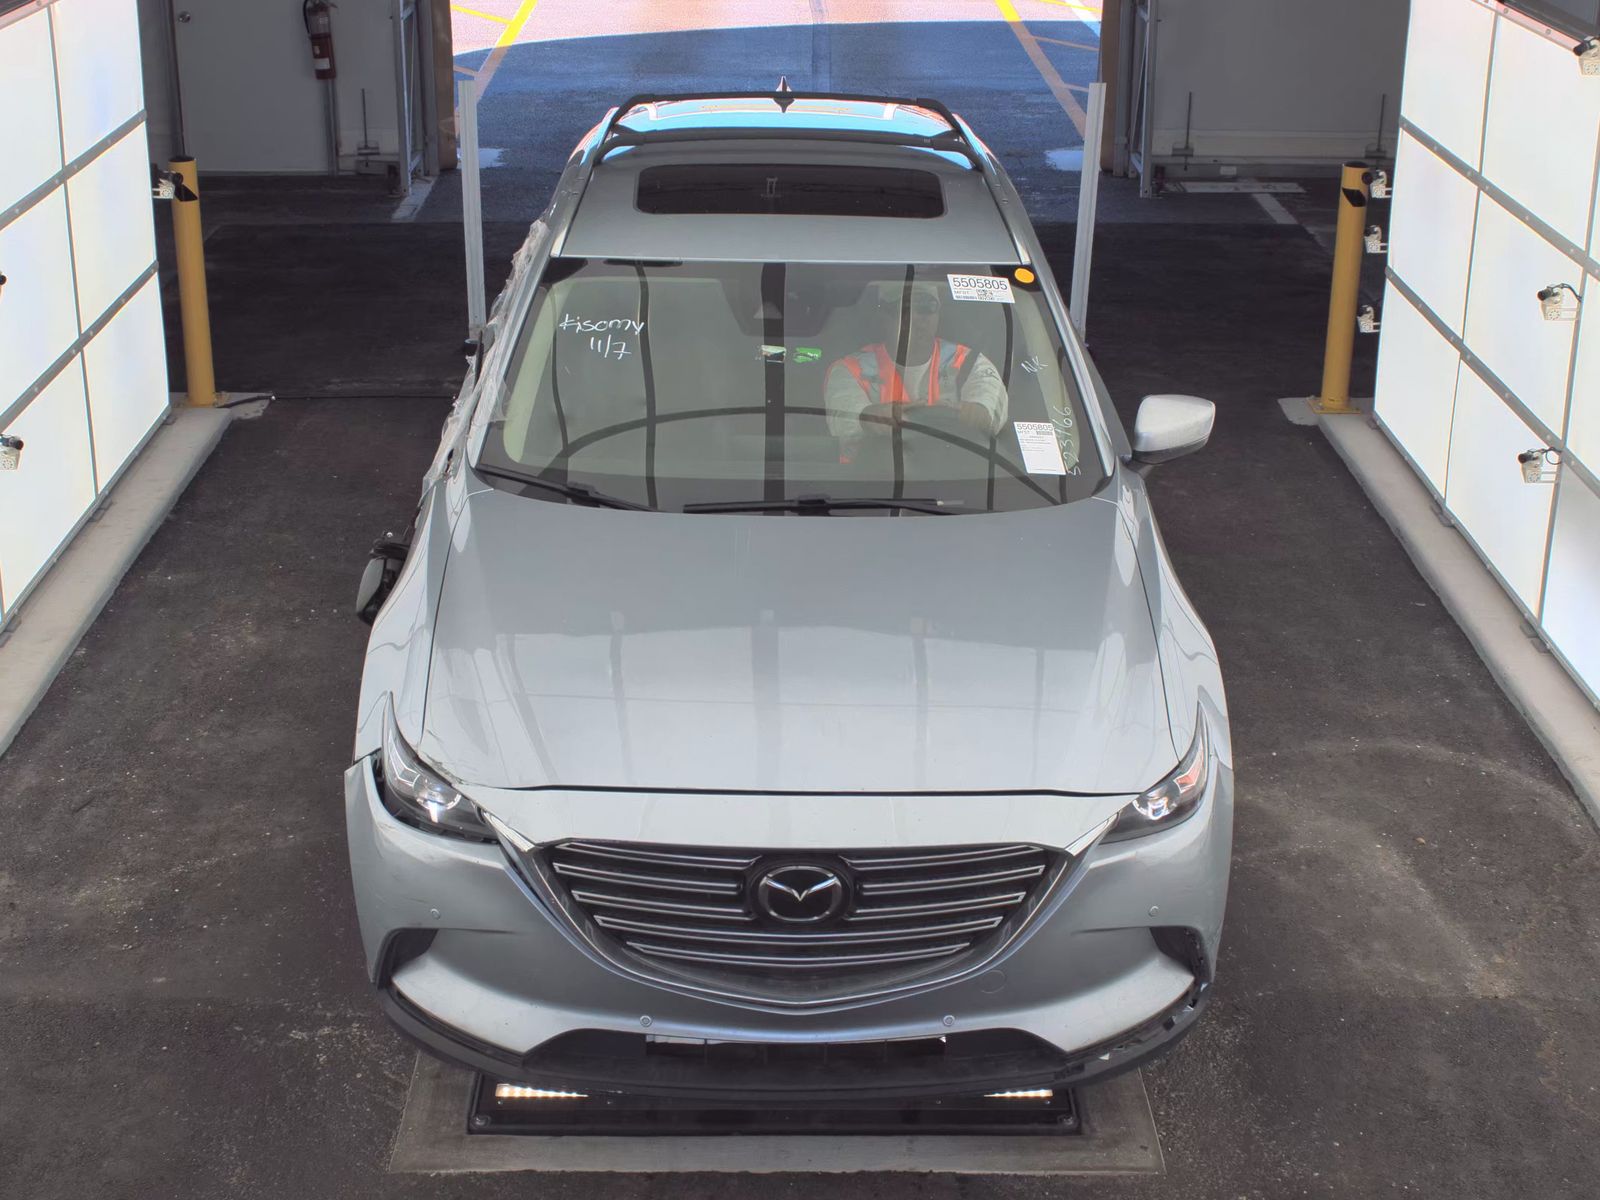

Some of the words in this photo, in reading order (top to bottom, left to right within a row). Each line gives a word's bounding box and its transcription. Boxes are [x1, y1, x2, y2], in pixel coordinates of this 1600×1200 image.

[952, 277, 1008, 291] 5505805
[590, 334, 632, 360] 11/7
[1016, 423, 1054, 432] 5505805
